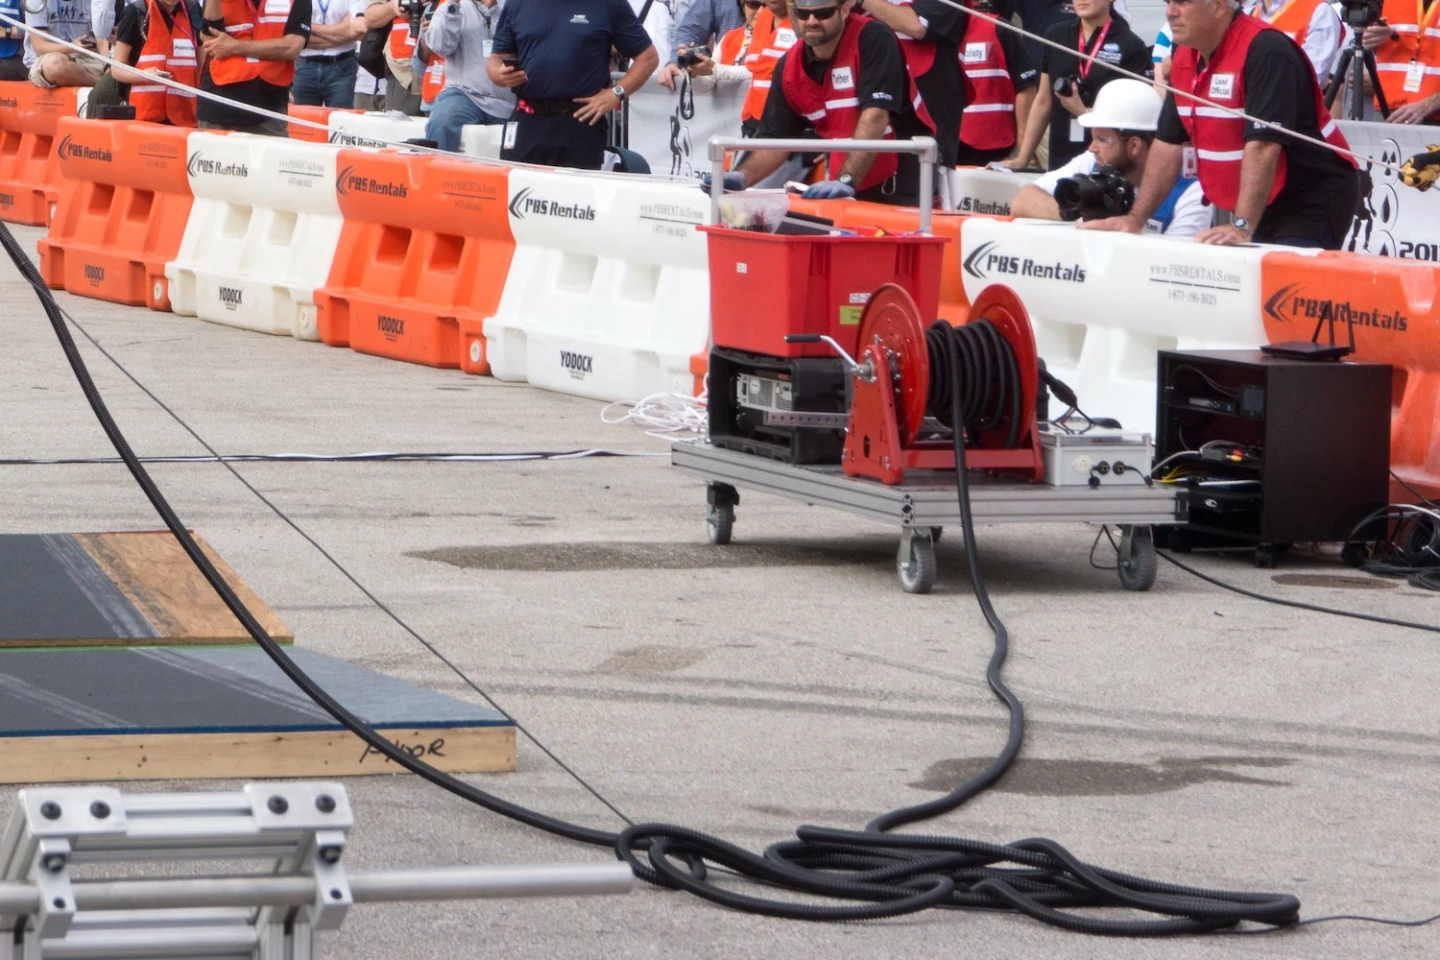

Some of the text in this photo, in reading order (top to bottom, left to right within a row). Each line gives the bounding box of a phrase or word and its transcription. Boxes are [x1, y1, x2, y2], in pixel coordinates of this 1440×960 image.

[1215, 76, 1228, 86] Lead
[67, 142, 113, 162] PBS Rentals
[197, 158, 248, 178] PBS Rentals
[348, 175, 408, 198] PBS Rentals
[524, 197, 596, 221] PBS Rentals
[1399, 241, 1440, 262] 201
[84, 264, 105, 281] YODOCK
[986, 253, 1086, 283] PBS Rentals
[218, 286, 243, 304] YODOCK
[377, 314, 405, 335] YODOCK
[1332, 302, 1408, 331] Rentals
[560, 350, 593, 373] YODOCK
